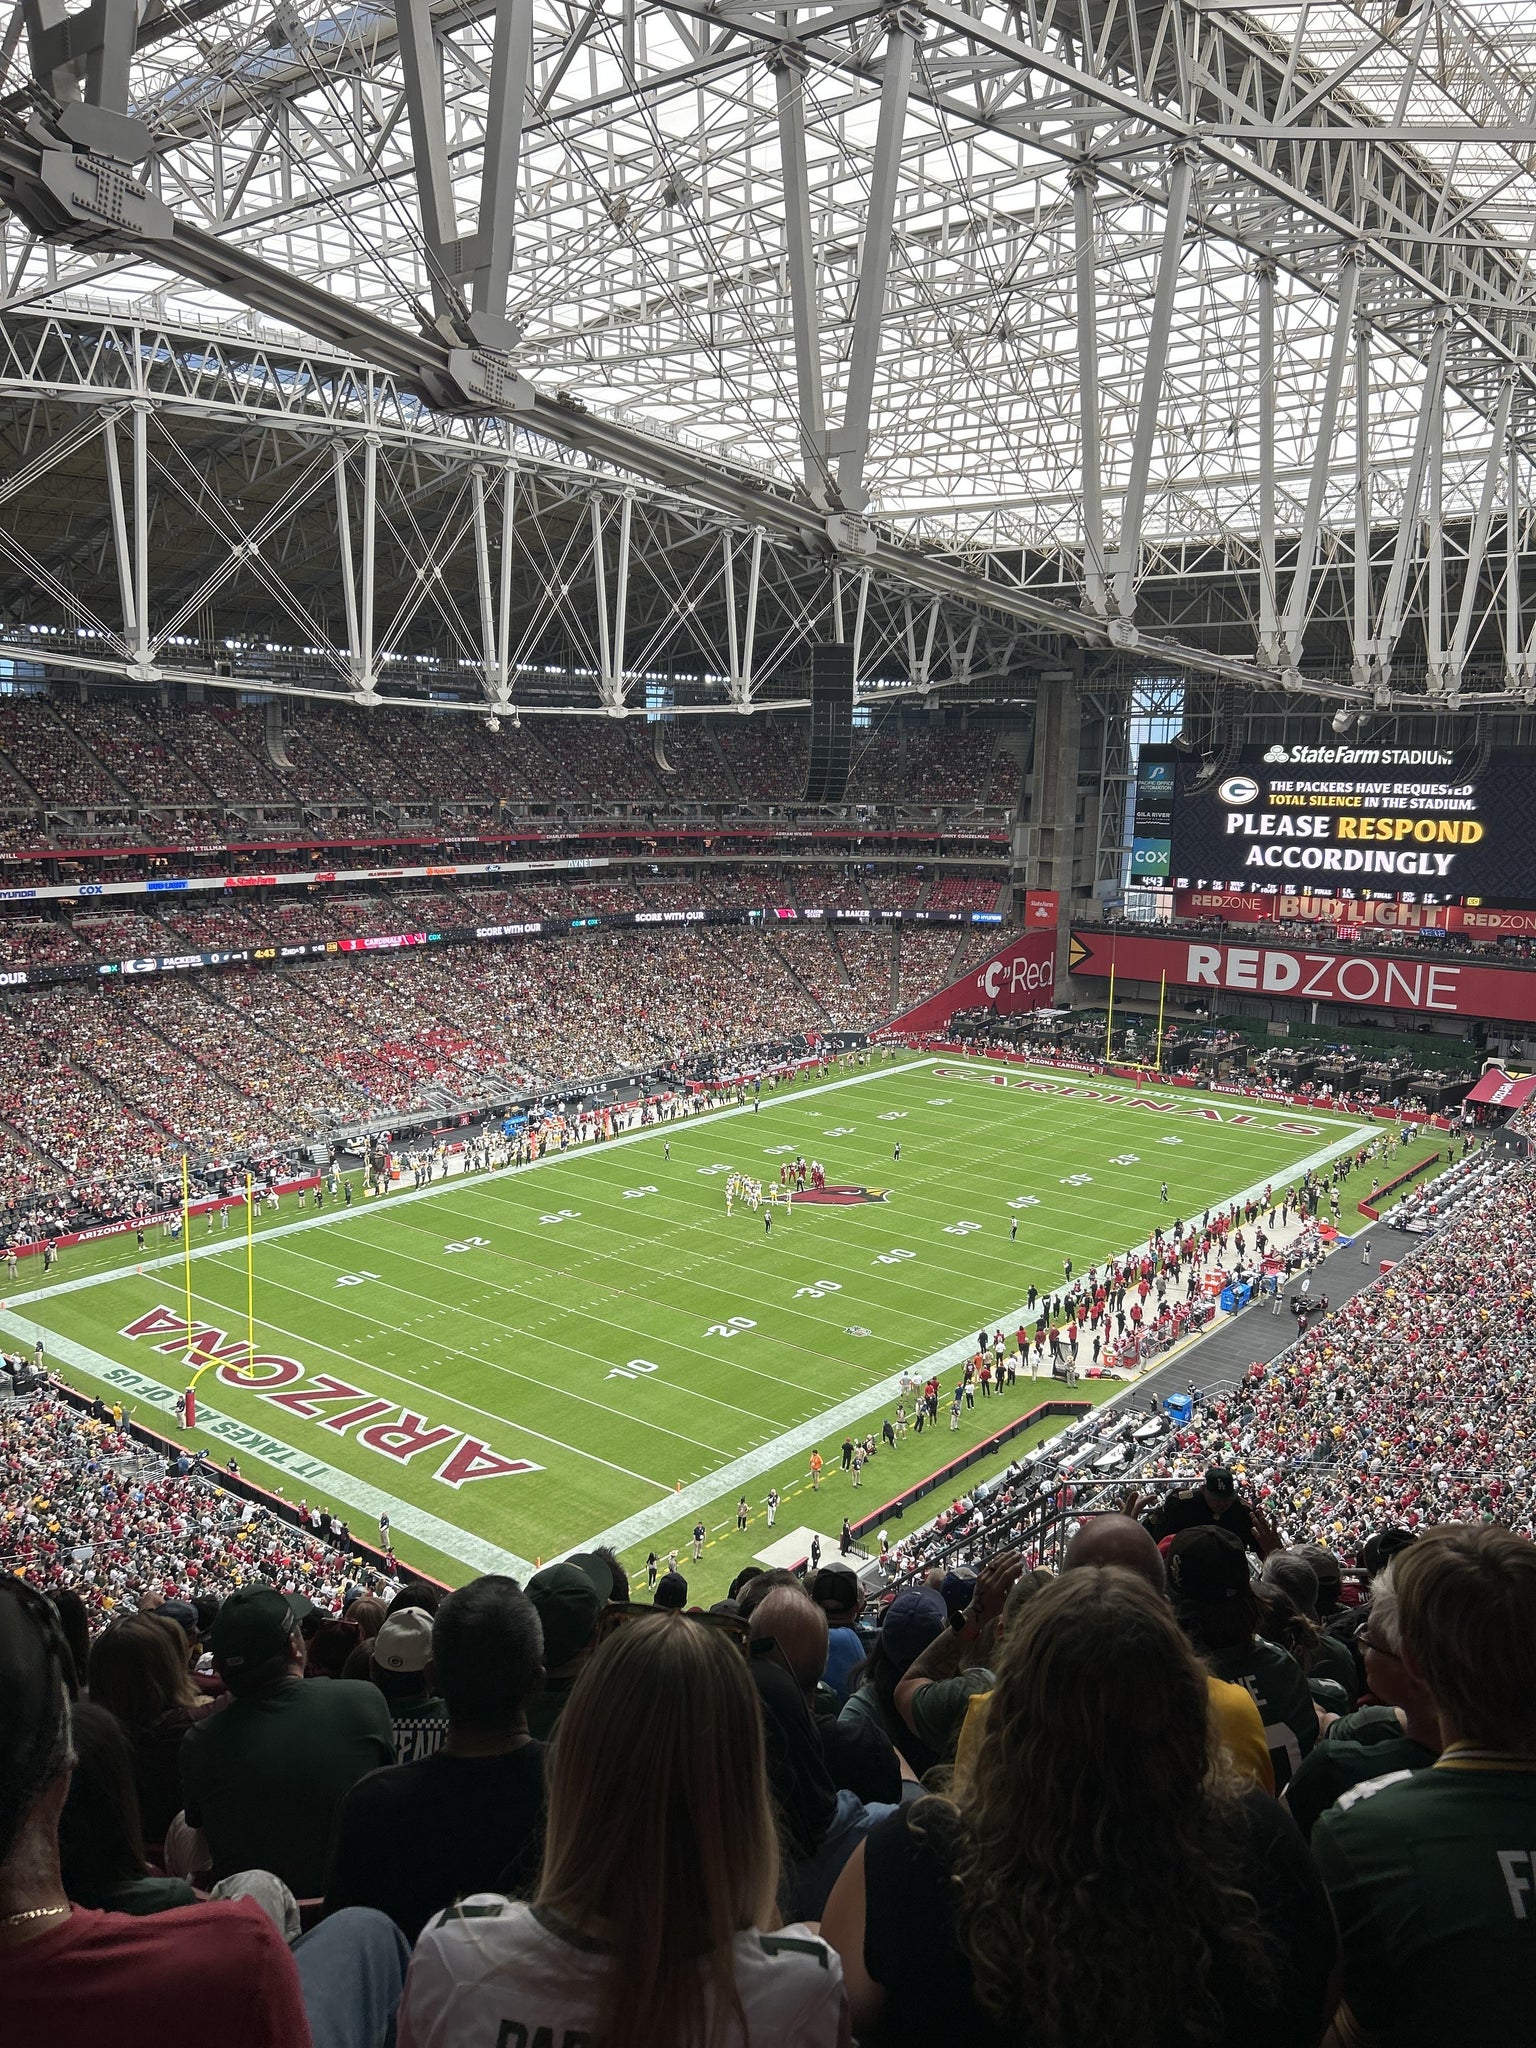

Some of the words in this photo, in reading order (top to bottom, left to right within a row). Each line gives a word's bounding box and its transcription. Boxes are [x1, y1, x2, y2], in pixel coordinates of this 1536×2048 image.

[1270, 781, 1293, 792] THE
[1296, 781, 1353, 793] PACKERS
[1356, 783, 1390, 793] HAVE
[1269, 795, 1306, 806] TOTAL
[1309, 796, 1362, 808] SILENCE
[1364, 798, 1380, 808] IN
[1382, 798, 1407, 809] THE
[1410, 799, 1477, 811] STADIUM.
[1226, 813, 1330, 838] PLEASE
[1337, 816, 1483, 844] RESPOND
[567, 859, 593, 868] AVNET
[1135, 850, 1168, 864] COX
[1245, 845, 1455, 876] ACCORDINGLY
[1142, 876, 1163, 887] 4:43
[79, 886, 102, 895] COX
[1192, 895, 1261, 911] REDZONE
[635, 912, 662, 922] SCORE
[663, 912, 685, 920] WITH
[686, 911, 704, 920] OUR
[1279, 896, 1342, 920] BUD
[1348, 900, 1442, 928] LIGHT
[476, 927, 502, 937] SCORE
[503, 924, 524, 935] WITH
[524, 923, 541, 932] OUR
[163, 955, 201, 966] PACKERS
[254, 948, 275, 958] 4:43
[0, 971, 28, 985] OUR
[1186, 944, 1460, 1010] REDZONE
[932, 1068, 1326, 1136] CARDINALS
[1108, 1154, 1141, 1166] 20
[697, 1164, 734, 1175] 50
[1059, 1174, 1094, 1187] 30
[622, 1185, 659, 1198] 40
[1006, 1195, 1041, 1209] 40
[539, 1209, 582, 1223] 30
[78, 1224, 127, 1242] ARIZONA
[942, 1220, 983, 1236] 50
[445, 1236, 491, 1252] 20
[876, 1248, 917, 1265] 40
[336, 1270, 382, 1286] 10
[796, 1280, 843, 1299] 30
[708, 1316, 758, 1338] 20
[609, 1359, 659, 1379] 10
[102, 1368, 145, 1388] US
[116, 1303, 546, 1490] ARIZONA
[133, 1385, 174, 1402] OF
[211, 1422, 297, 1467] TAKES
[286, 1462, 331, 1480] IT
